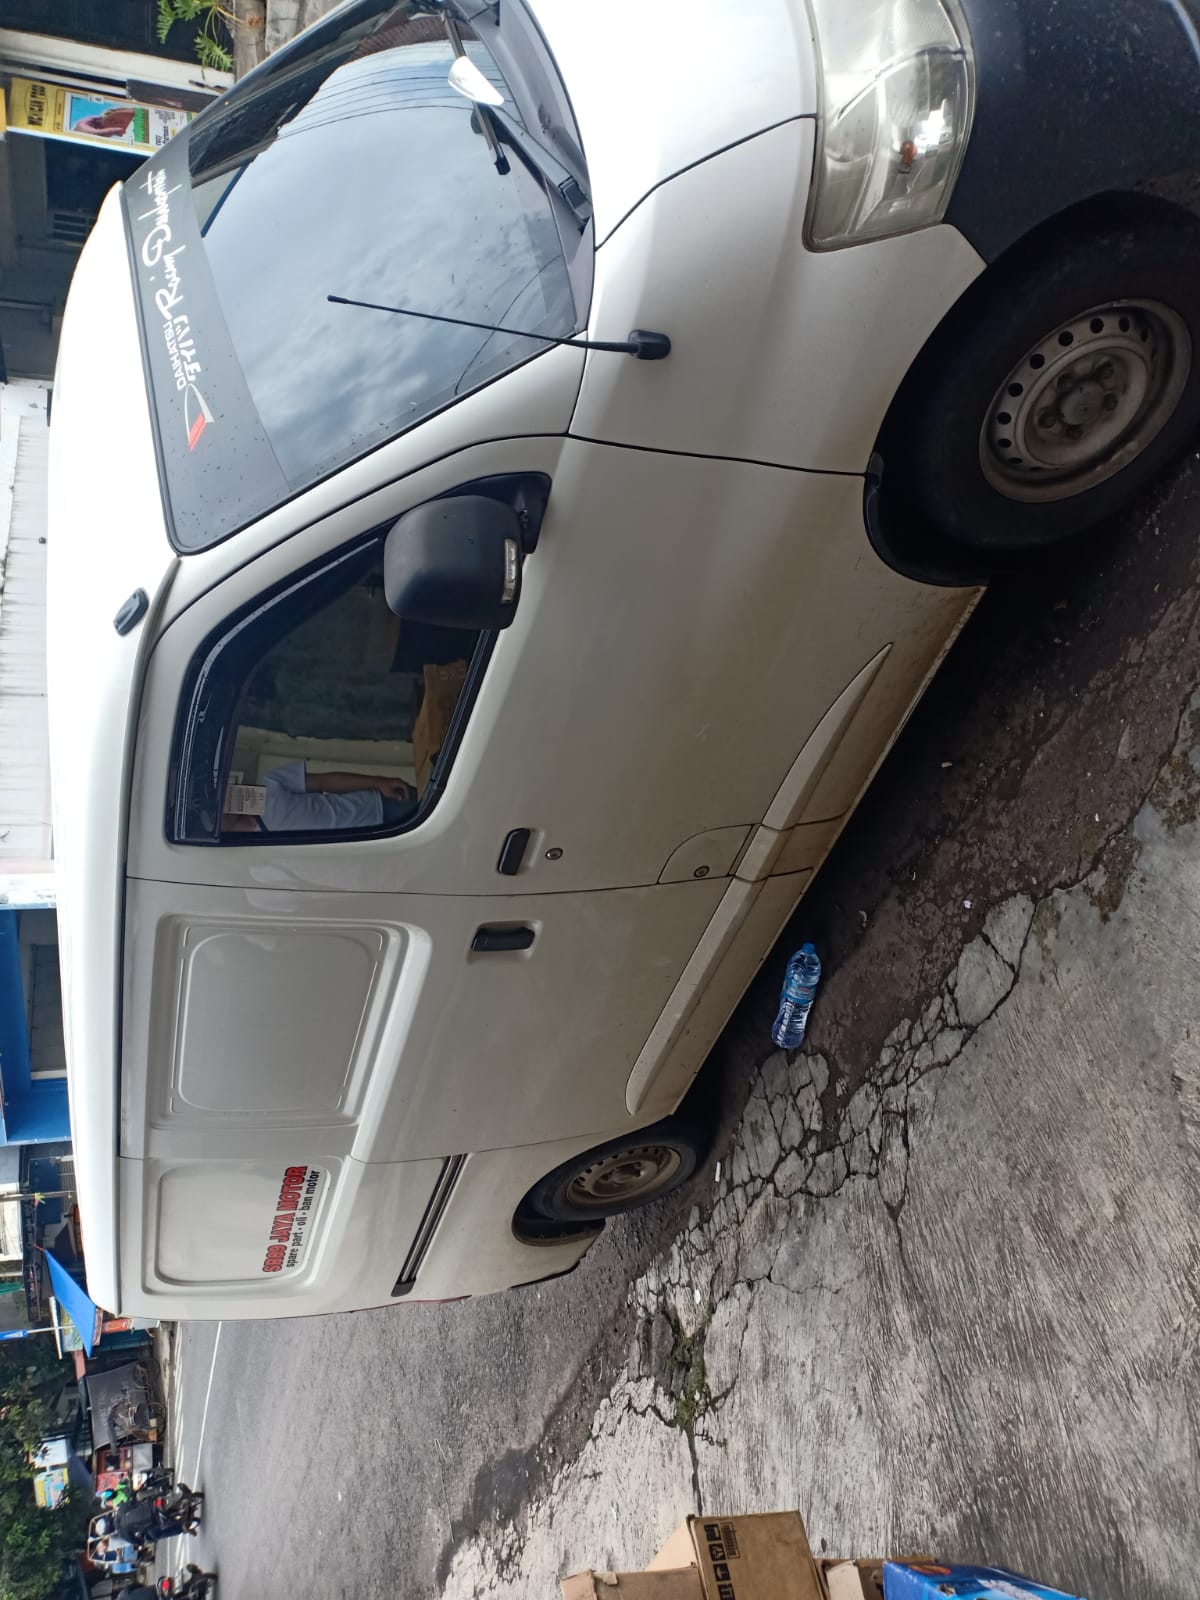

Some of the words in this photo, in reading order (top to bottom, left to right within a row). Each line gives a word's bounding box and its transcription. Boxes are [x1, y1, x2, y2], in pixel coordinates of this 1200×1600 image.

[164, 323, 187, 390] DAIHATSU
[276, 1166, 308, 1211] MOTOR
[306, 1171, 320, 1194] motor
[299, 1196, 312, 1210] ban
[270, 1213, 296, 1242] JAYA
[296, 1217, 307, 1226] oli
[292, 1233, 303, 1246] part
[286, 1248, 298, 1267] spare
